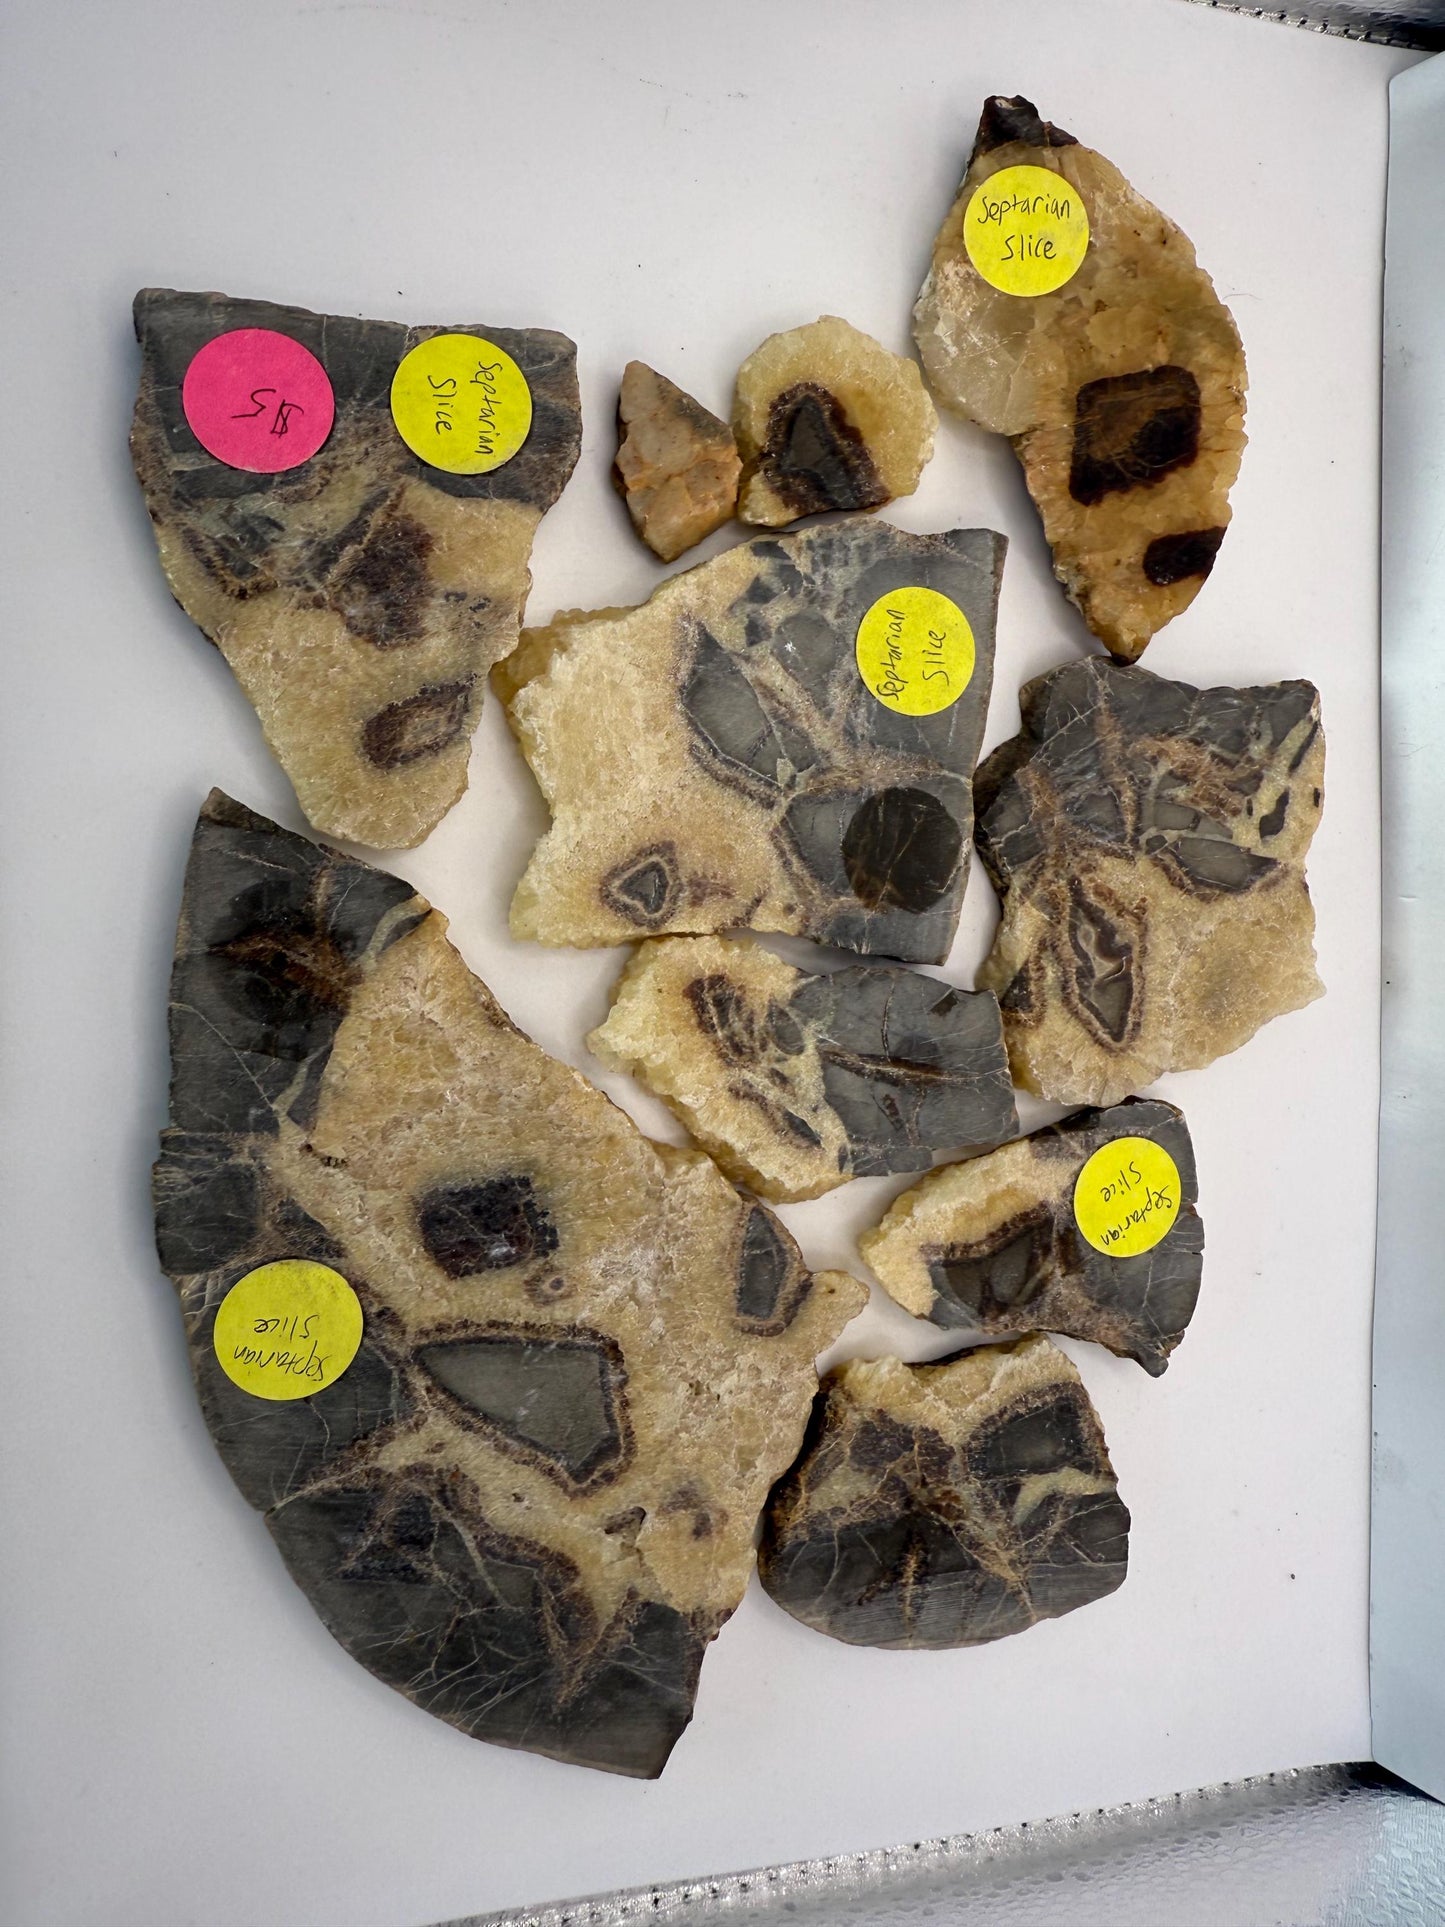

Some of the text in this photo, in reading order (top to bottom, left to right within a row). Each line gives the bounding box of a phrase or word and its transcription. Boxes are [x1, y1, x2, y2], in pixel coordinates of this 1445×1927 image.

[1000, 234, 1058, 262] Slice
[230, 388, 305, 439] $5
[427, 374, 458, 435] Slice
[921, 630, 950, 687] Slice
[1099, 1160, 1142, 1203] Slice
[253, 1313, 321, 1343] Slice
